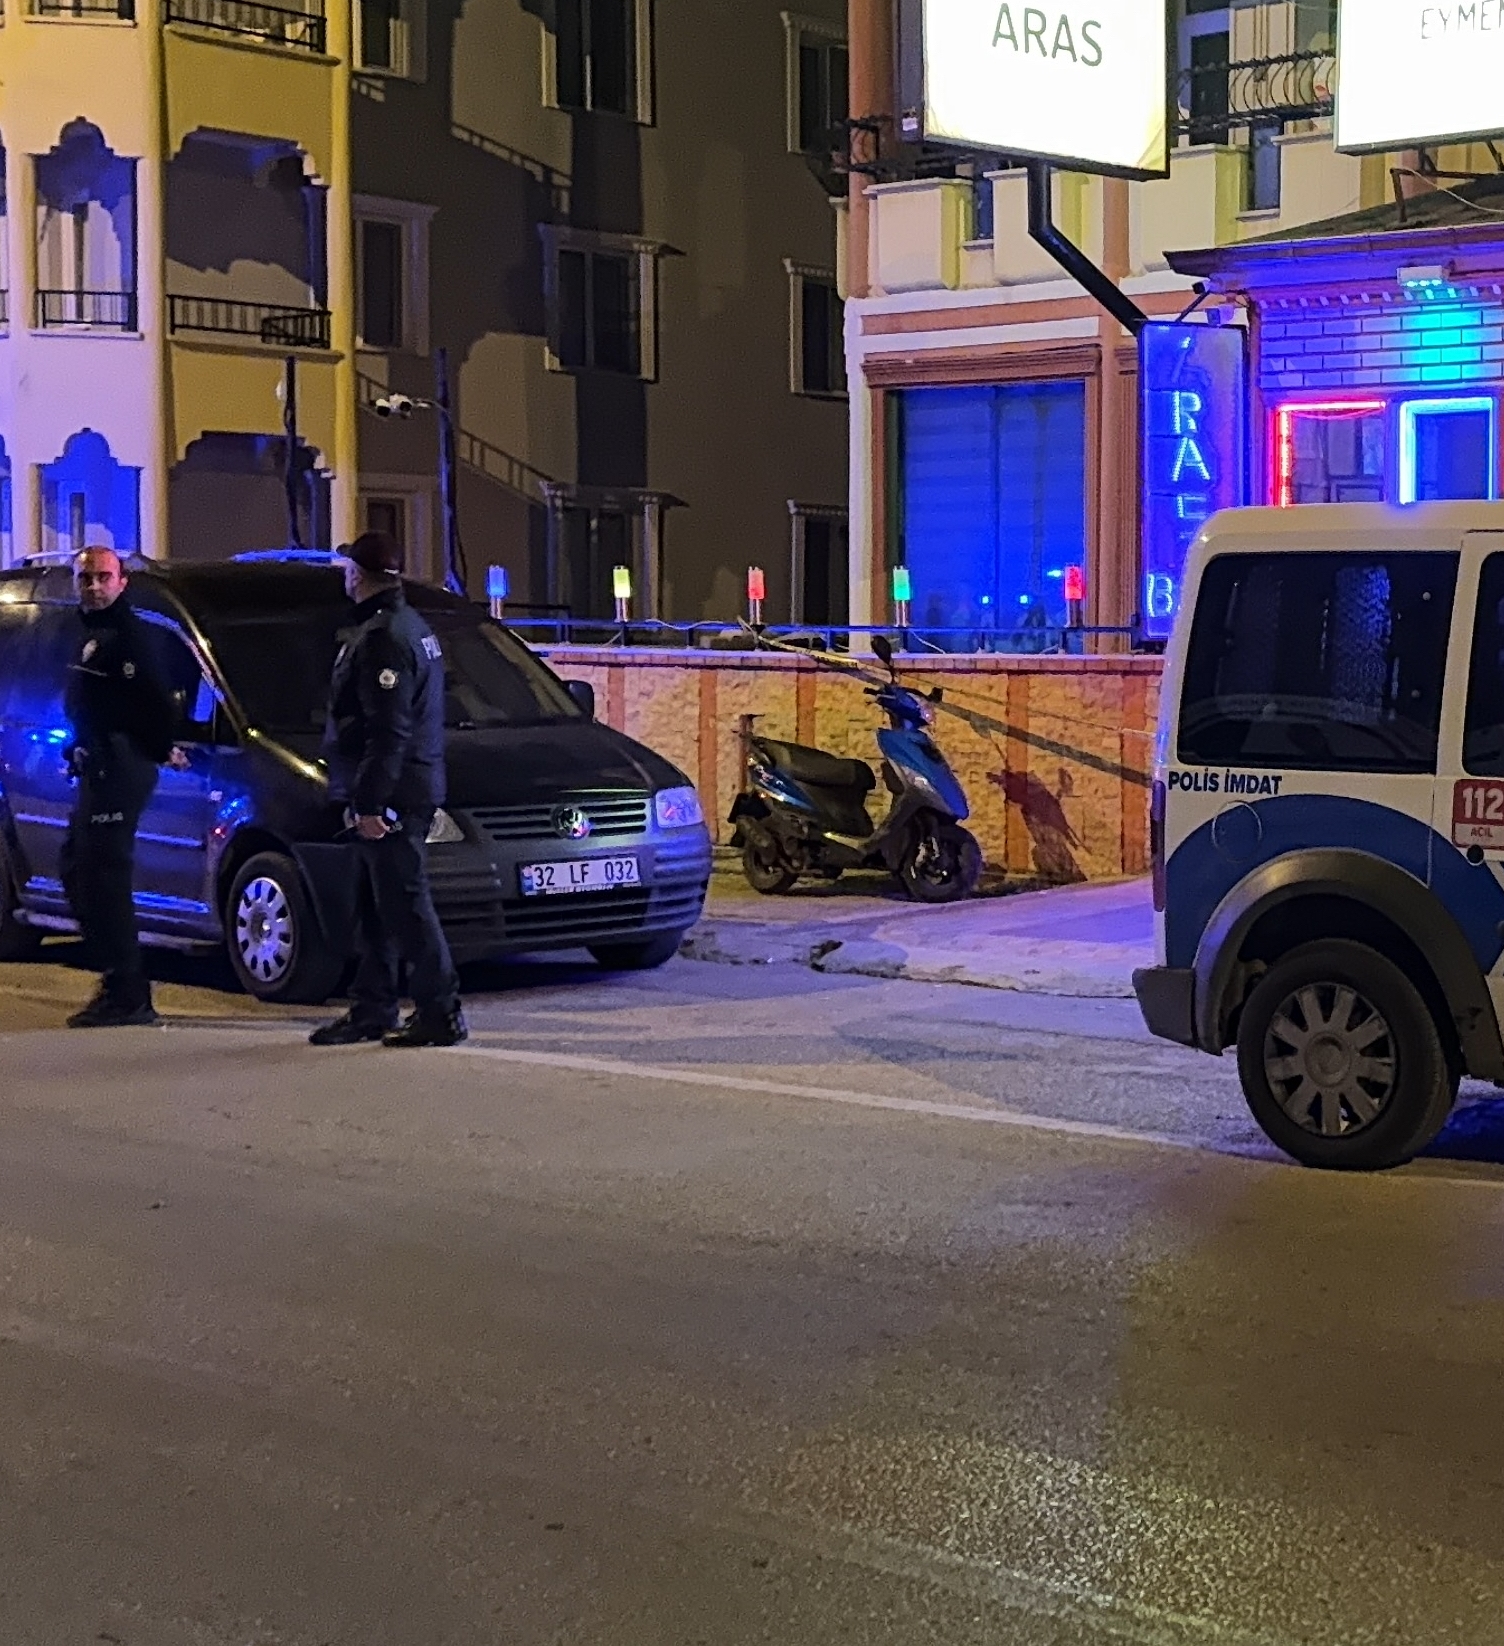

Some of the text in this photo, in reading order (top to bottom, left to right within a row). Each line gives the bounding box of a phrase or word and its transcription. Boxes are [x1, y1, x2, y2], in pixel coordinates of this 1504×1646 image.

[992, 3, 1102, 66] ARAS
[1168, 767, 1283, 795] POLİS İMDAT
[1462, 787, 1504, 820] 112
[533, 860, 634, 887] 32 LF 032
